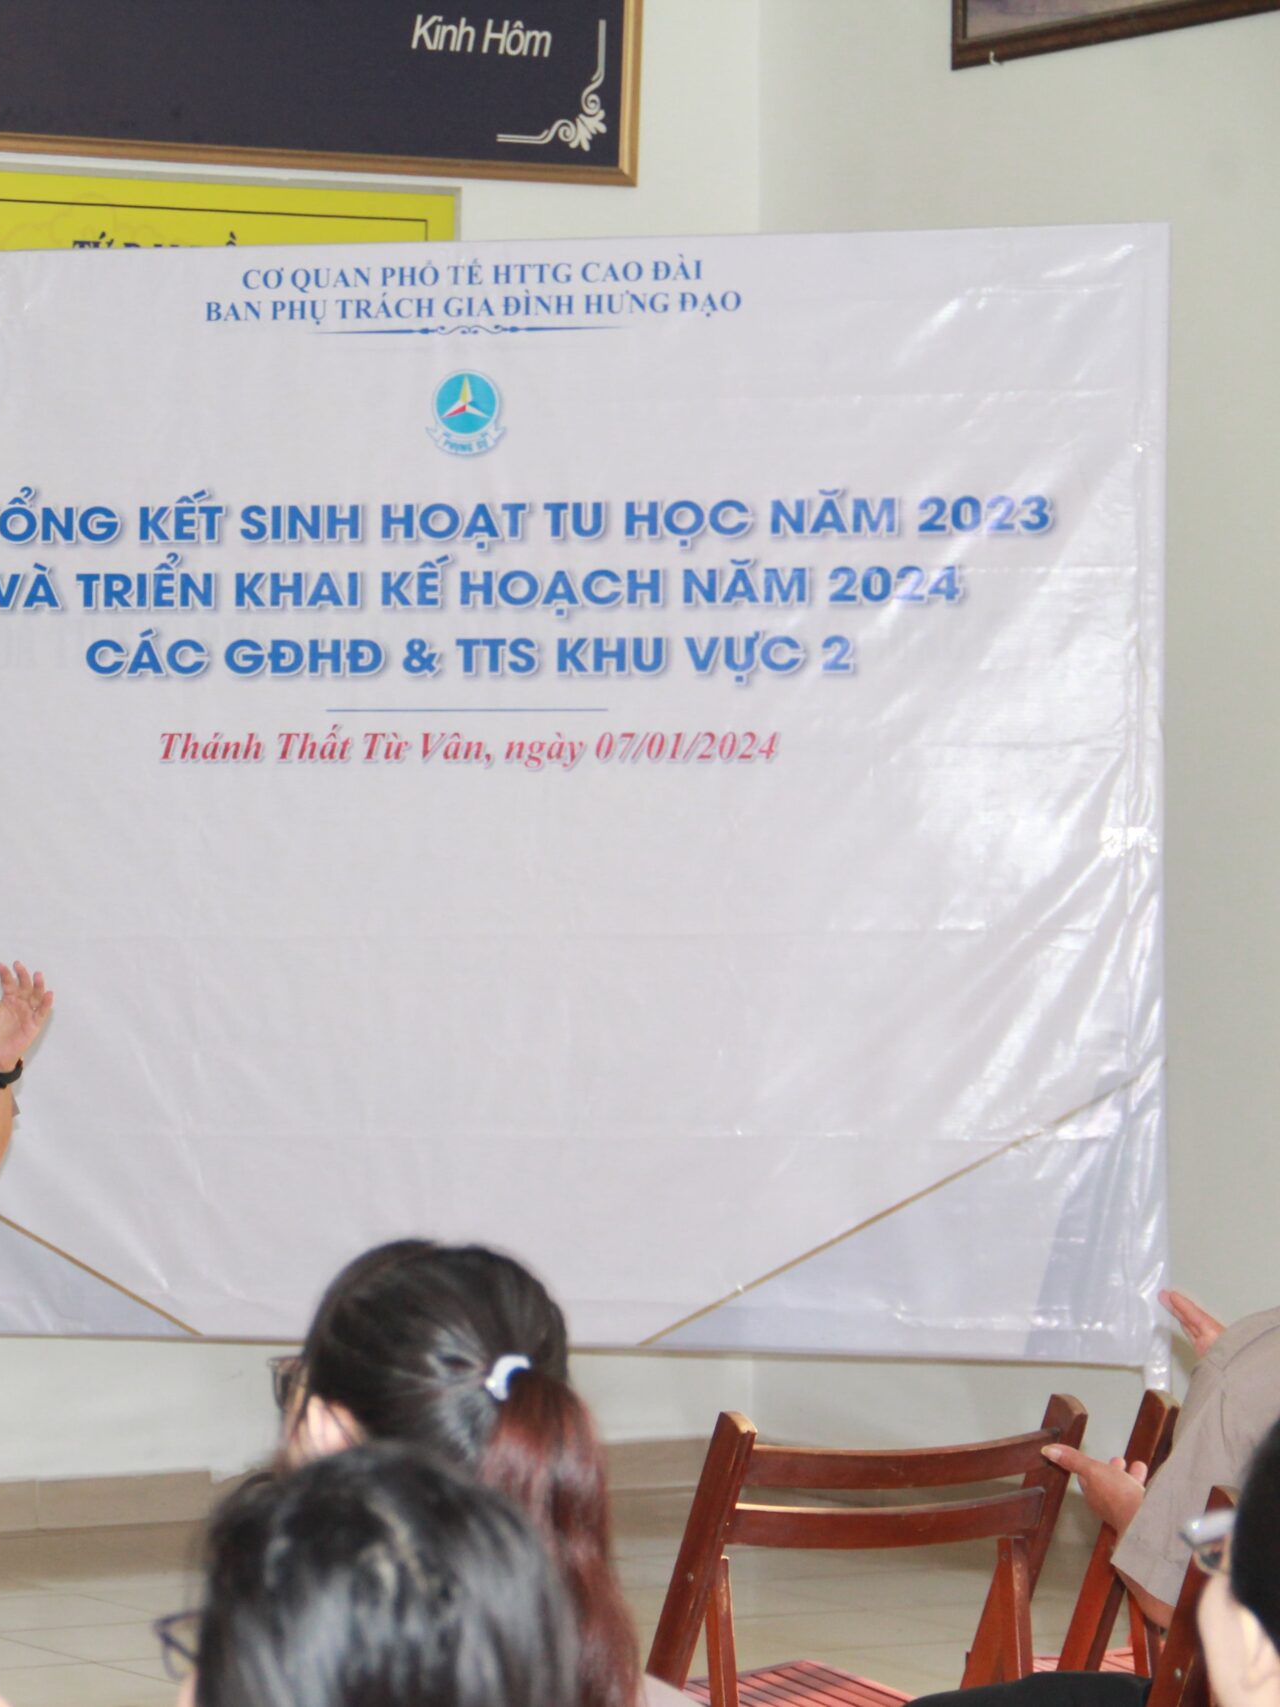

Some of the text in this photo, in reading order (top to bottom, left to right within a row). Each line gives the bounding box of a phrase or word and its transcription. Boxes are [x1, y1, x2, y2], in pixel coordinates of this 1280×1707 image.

[411, 14, 552, 57] Kinh Hôm
[242, 266, 284, 289] CƠ
[291, 266, 371, 293] QUAN
[493, 262, 572, 285] HTTG
[581, 260, 643, 283] CAO
[652, 254, 702, 282] ĐÀI
[205, 288, 741, 326] BAN PHỤ TRÁCH GIA ĐÌNH HƯNG ĐẠO
[138, 489, 223, 541] KẾT
[240, 504, 360, 541] SINH
[381, 502, 526, 549] HOẠT
[543, 501, 603, 538] TU
[624, 499, 753, 548] HỌC
[770, 488, 895, 536] NĂM
[917, 495, 1053, 534] 2023
[76, 552, 213, 608] TRIỂN
[235, 571, 359, 608] KHAI
[381, 554, 450, 607] KẾ
[460, 568, 661, 616] HOẠCH
[683, 558, 807, 605] NĂM
[828, 565, 960, 602] 2024
[85, 628, 210, 675] CÁC
[224, 638, 384, 675] GĐHĐ
[401, 637, 438, 675] &
[456, 637, 538, 674] TTS
[556, 637, 664, 673] KHU
[683, 631, 802, 683] VỰC
[821, 635, 852, 672] 2
[159, 724, 779, 769] Thánh Thất Từ Vân, ngày 07/01/2024
